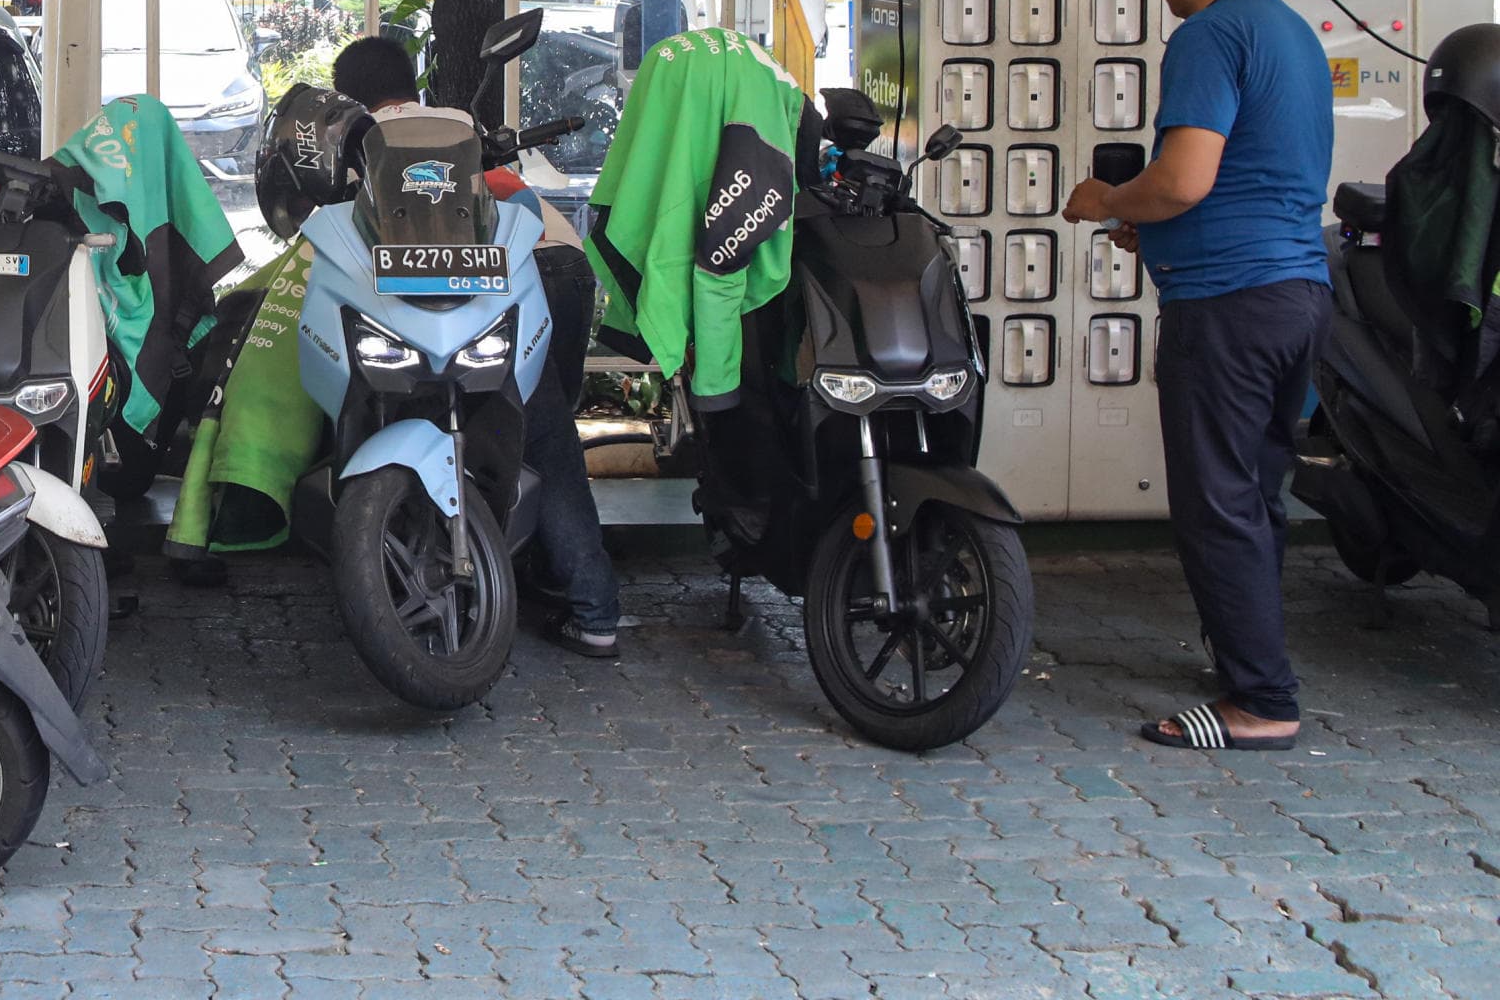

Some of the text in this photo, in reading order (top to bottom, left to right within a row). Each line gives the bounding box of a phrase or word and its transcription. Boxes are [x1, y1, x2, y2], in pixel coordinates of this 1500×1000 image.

[1360, 71, 1400, 83] PLN
[294, 120, 325, 170] NHK
[704, 169, 752, 229] gopay
[710, 188, 783, 266] tokopedia
[379, 249, 393, 270] B
[402, 248, 453, 270] 4279
[271, 277, 306, 298] oje
